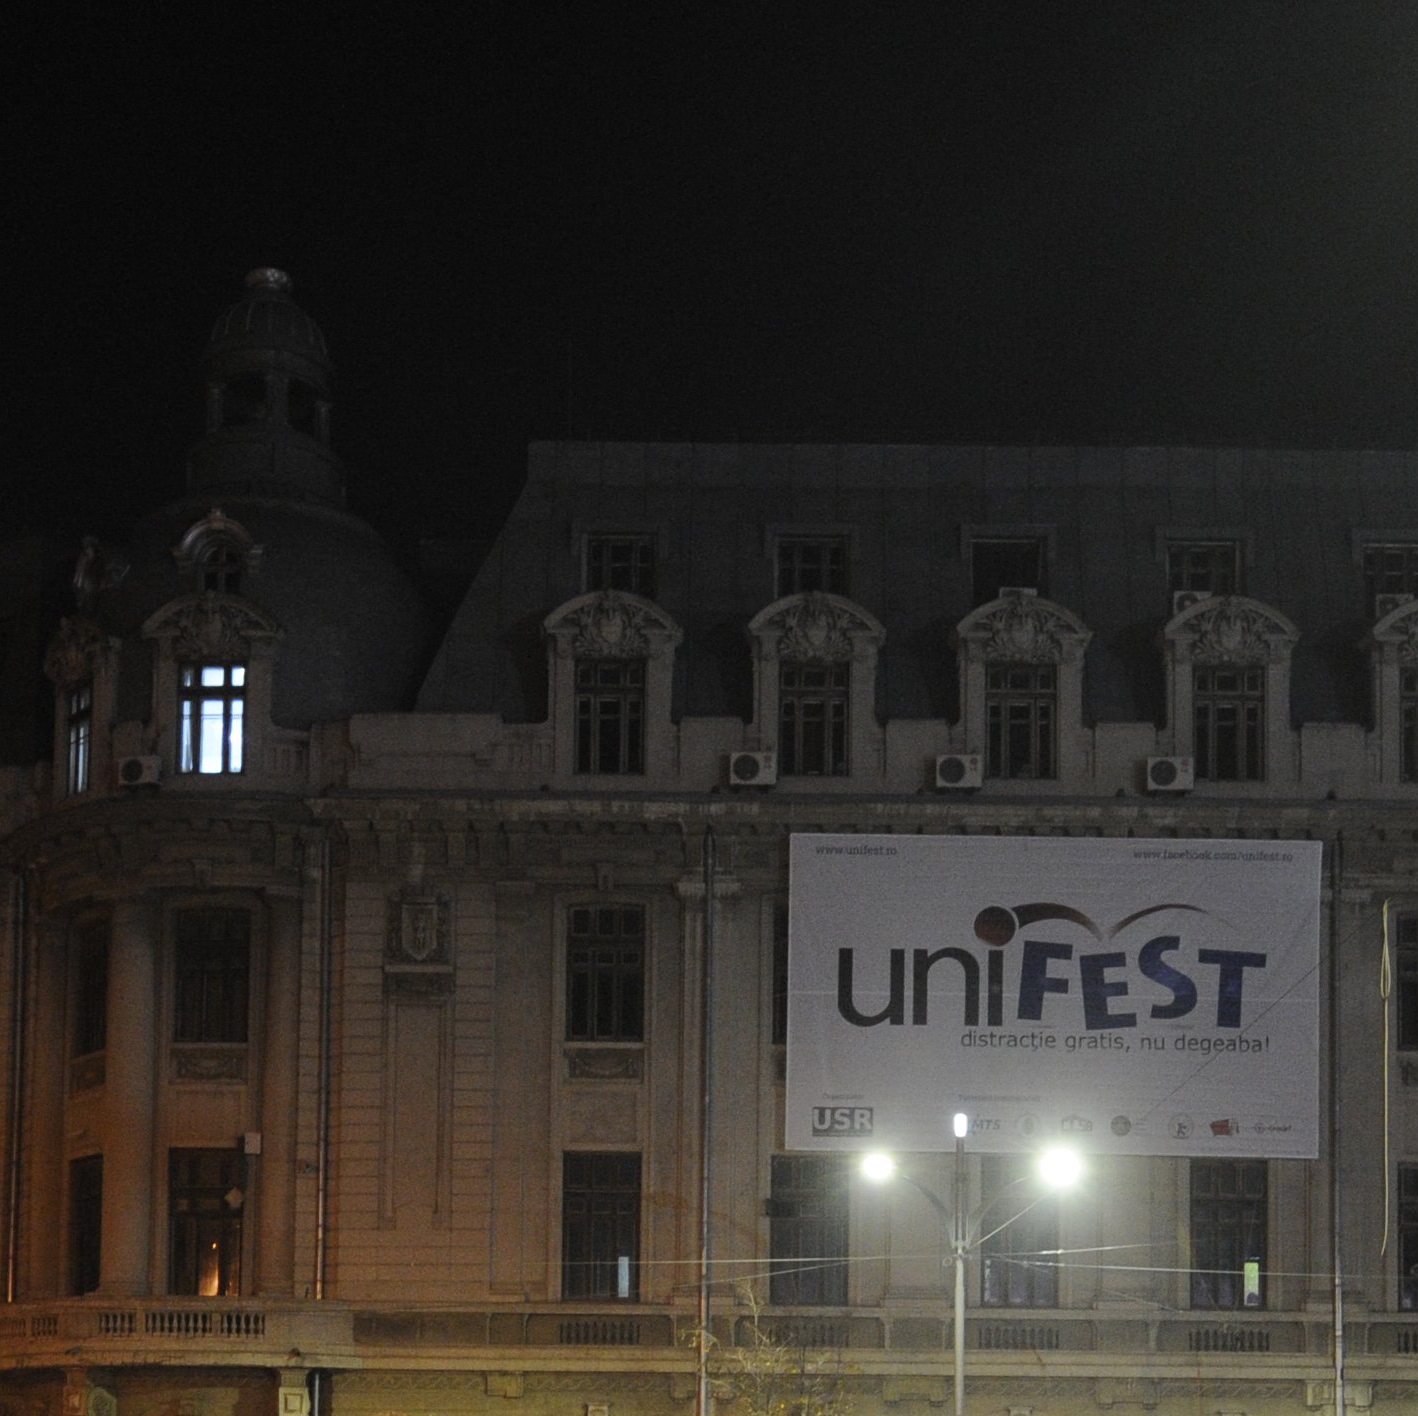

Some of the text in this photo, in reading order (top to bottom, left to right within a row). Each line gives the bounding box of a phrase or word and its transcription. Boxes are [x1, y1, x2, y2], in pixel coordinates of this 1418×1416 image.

[1065, 1032, 1131, 1053] gratis,
[1140, 1036, 1165, 1050] nu
[1174, 1034, 1270, 1055] degeaba!
[813, 1108, 872, 1131] USR
